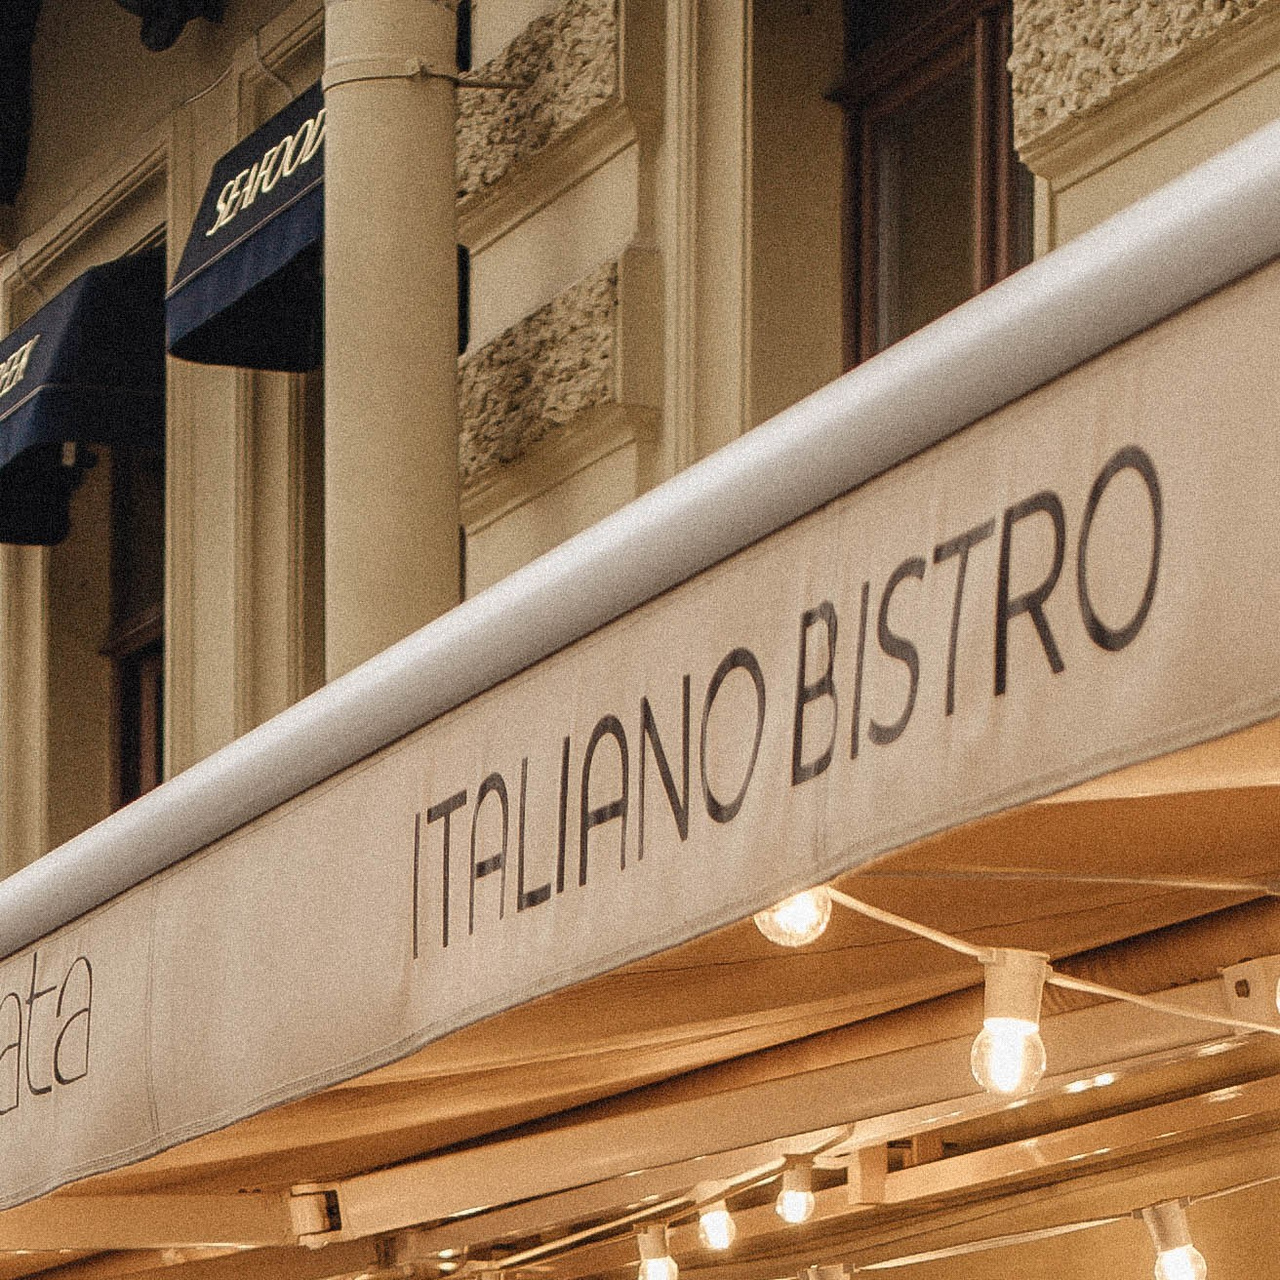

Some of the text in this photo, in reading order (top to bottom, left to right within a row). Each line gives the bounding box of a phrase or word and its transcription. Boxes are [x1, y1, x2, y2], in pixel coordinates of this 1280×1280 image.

[205, 107, 328, 237] SEAFOOD
[413, 444, 1163, 960] ITALIANO BISTRO
